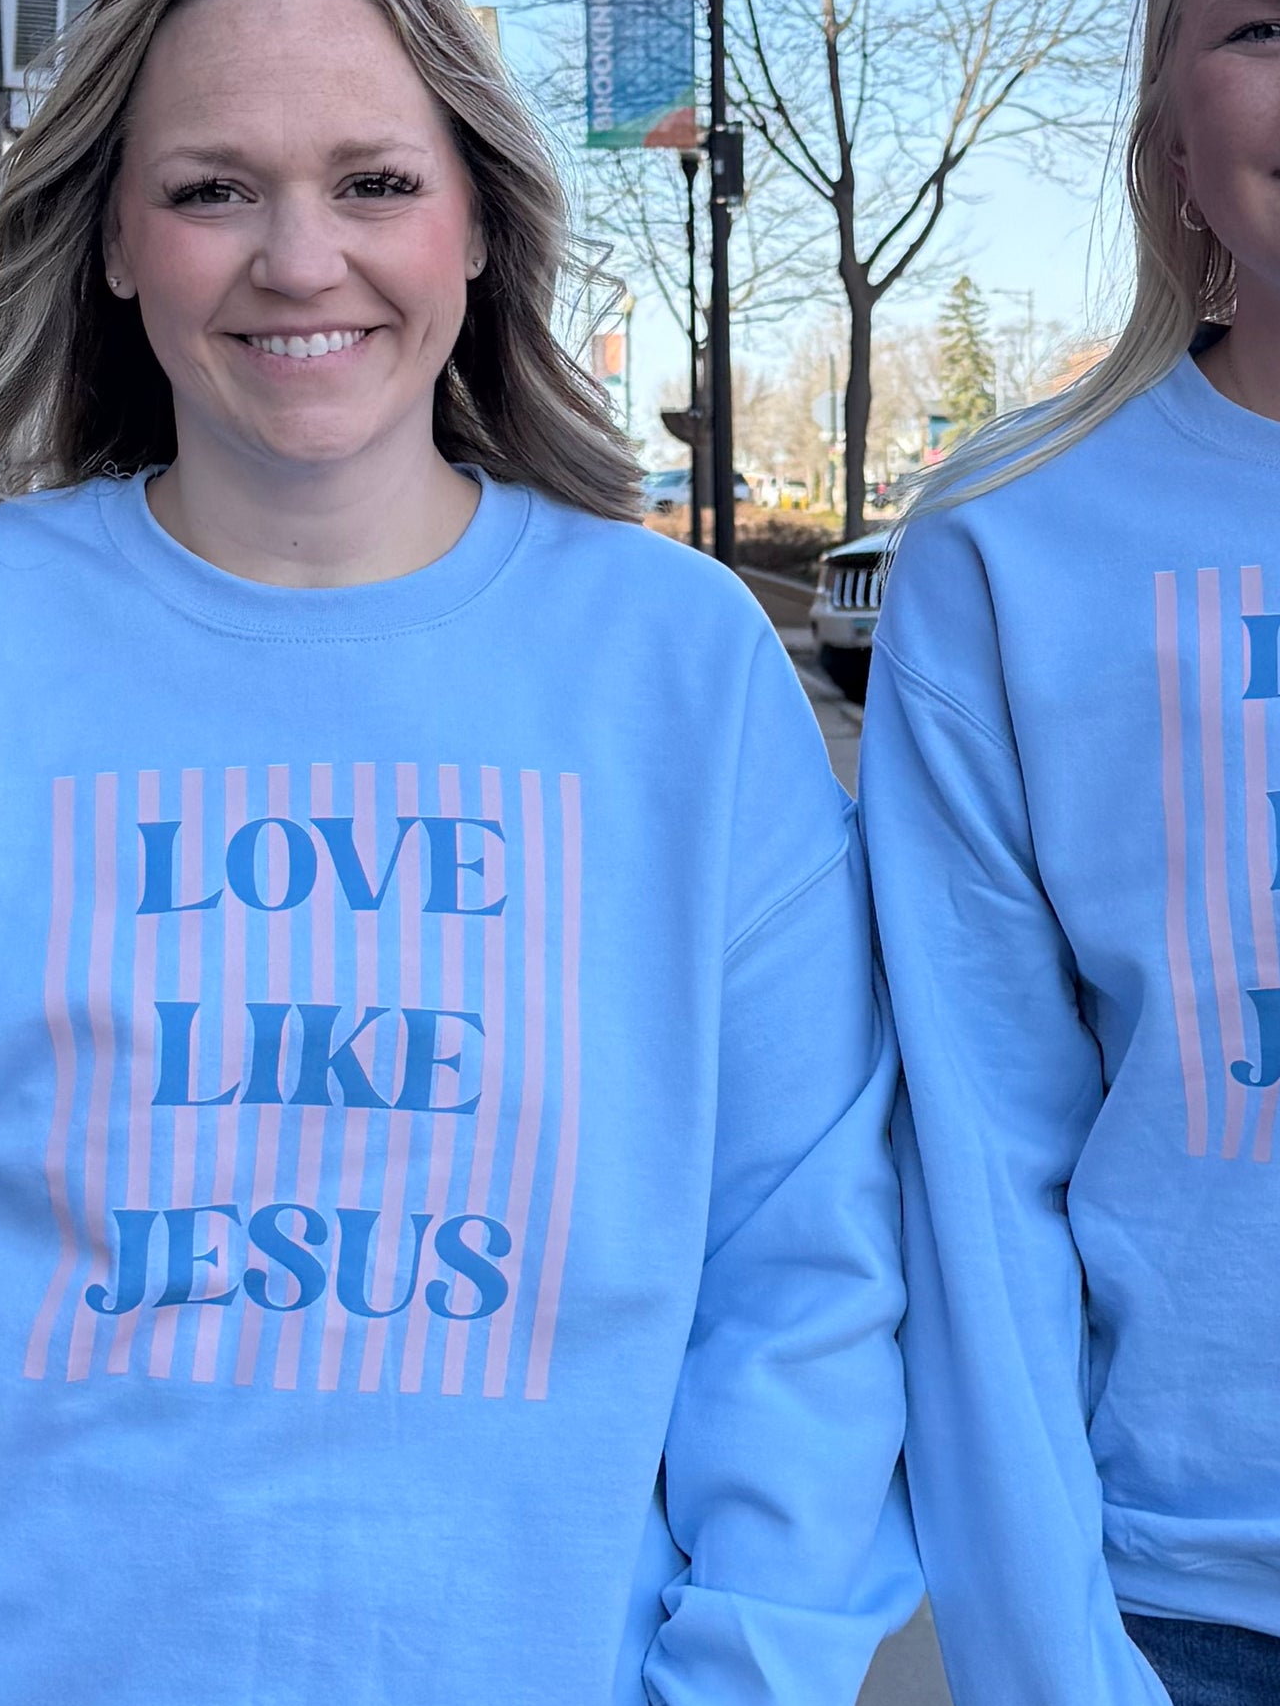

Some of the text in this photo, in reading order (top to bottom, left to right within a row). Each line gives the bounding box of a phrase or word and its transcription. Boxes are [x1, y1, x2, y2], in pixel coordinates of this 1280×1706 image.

[135, 816, 508, 916] LOVE
[150, 1000, 486, 1115] LIKE
[84, 1203, 513, 1320] JESUS
